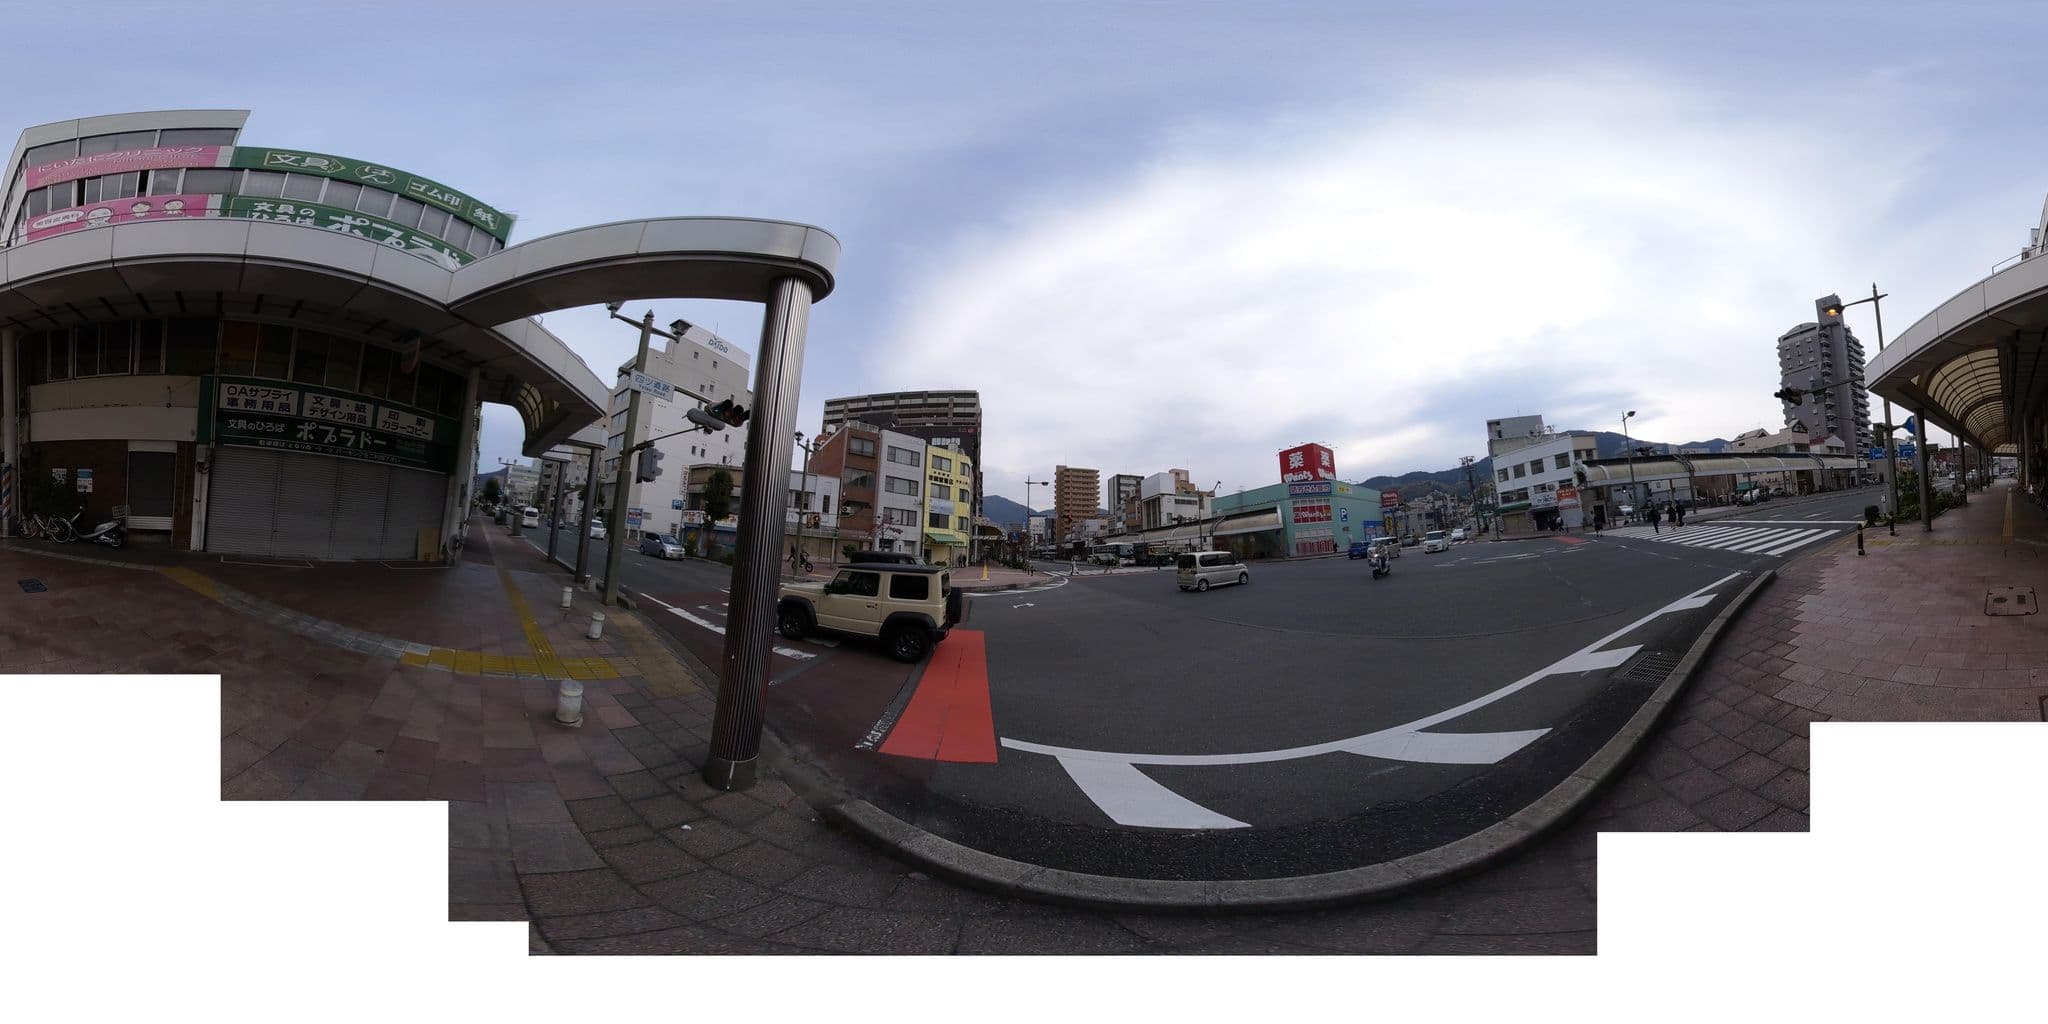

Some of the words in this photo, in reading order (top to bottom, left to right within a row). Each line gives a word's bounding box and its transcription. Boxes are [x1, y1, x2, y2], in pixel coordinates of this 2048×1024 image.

[270, 153, 330, 171] 文具
[410, 182, 462, 207] ゴム印
[253, 201, 316, 217] 文具の
[473, 206, 496, 229] 紙
[227, 385, 292, 401] OAサプライ
[227, 419, 285, 433] 文具のひろば
[382, 420, 429, 436] カラーコピー
[296, 421, 387, 449] ポプラドー
[1289, 451, 1304, 470] 薬
[1320, 450, 1331, 467] 薬
